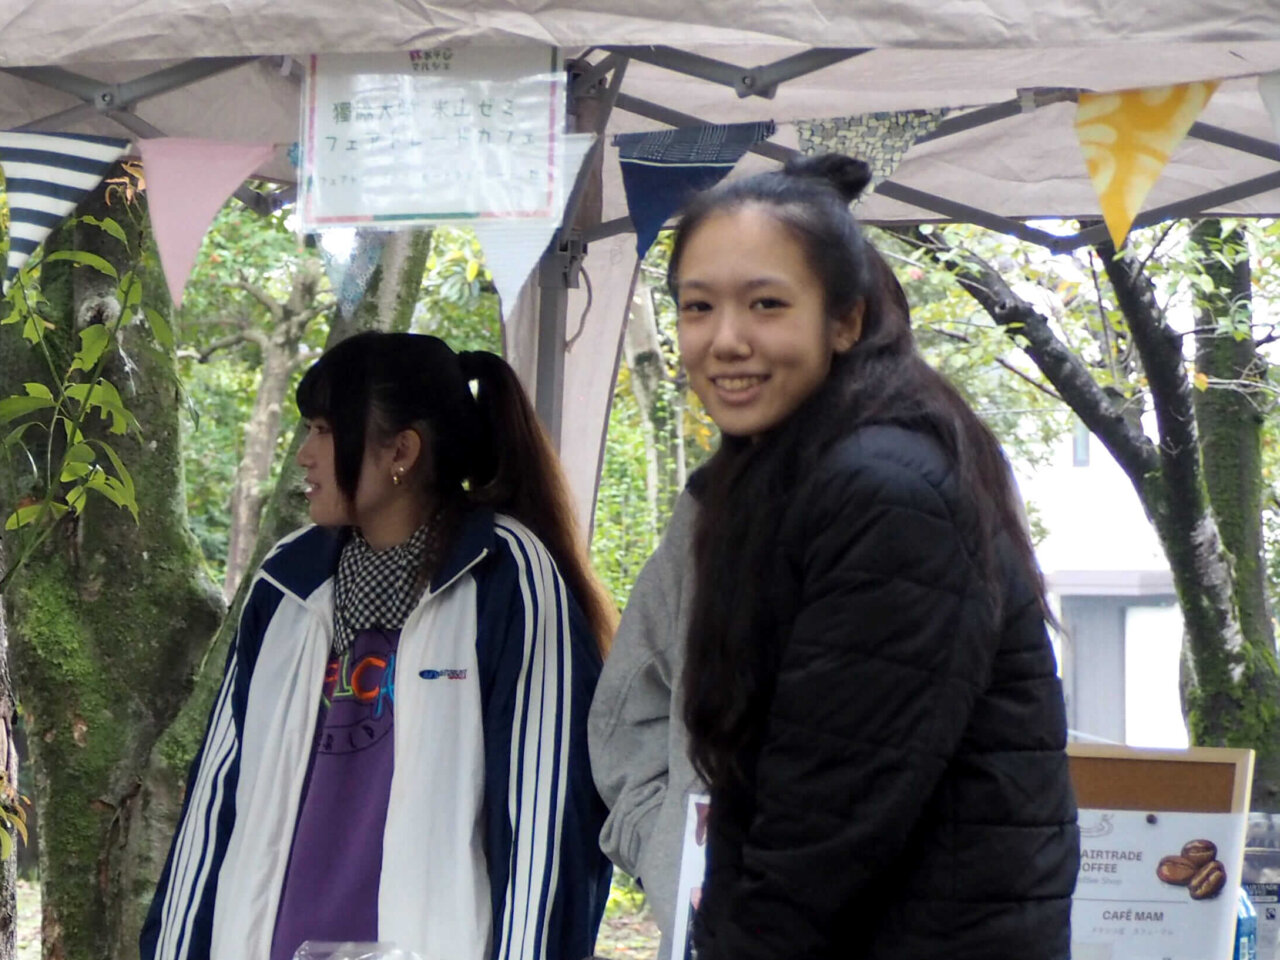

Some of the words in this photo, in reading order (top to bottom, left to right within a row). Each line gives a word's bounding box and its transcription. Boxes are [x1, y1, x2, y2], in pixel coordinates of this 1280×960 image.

[1080, 849, 1143, 861] AIRTRADE
[1081, 862, 1118, 874] OFFEE
[1102, 907, 1132, 921] CAFÉ
[1134, 911, 1164, 922] MAM
